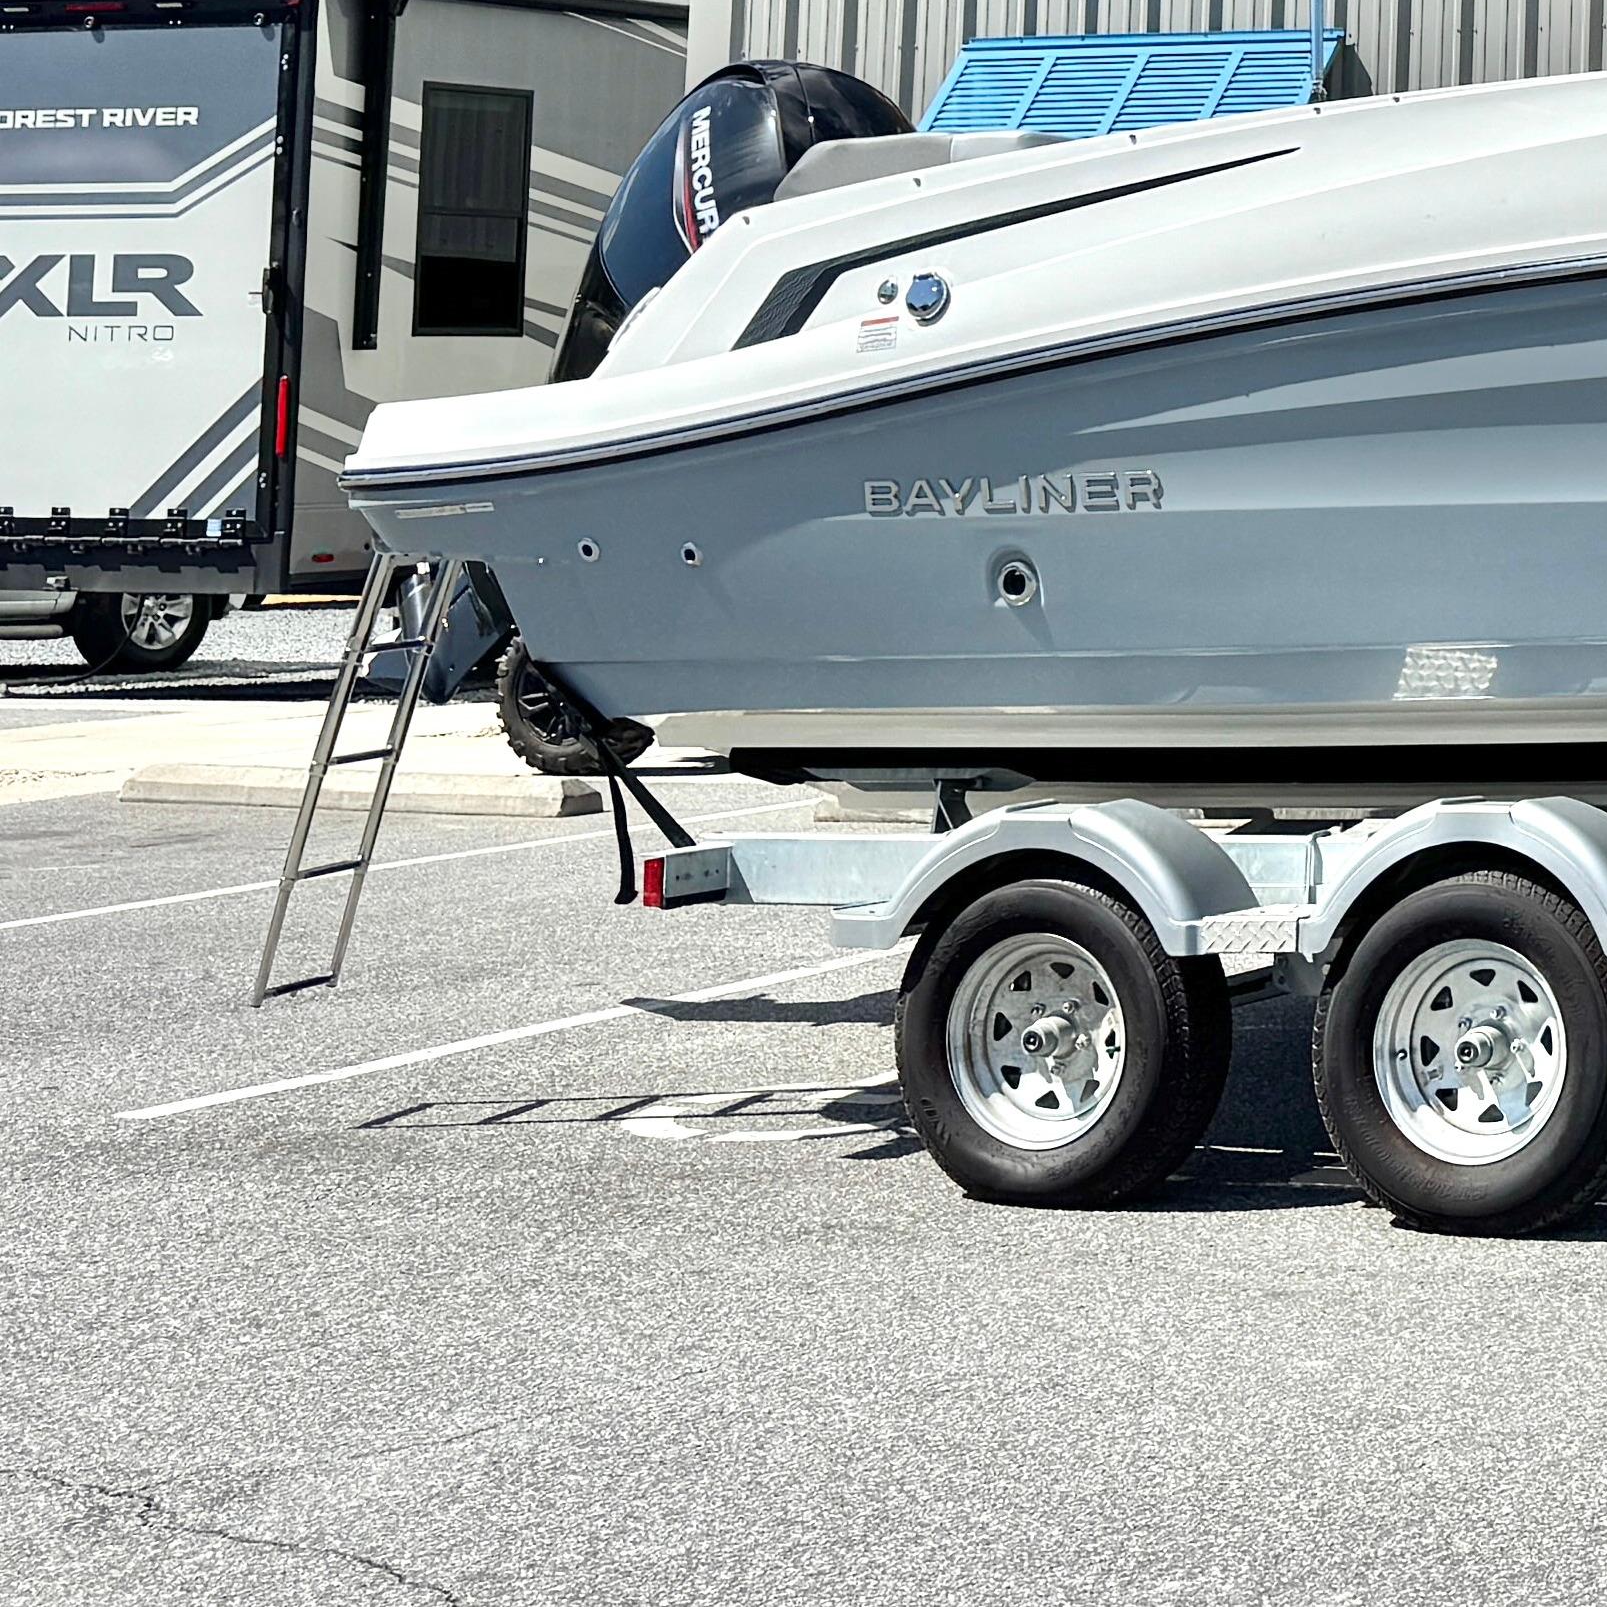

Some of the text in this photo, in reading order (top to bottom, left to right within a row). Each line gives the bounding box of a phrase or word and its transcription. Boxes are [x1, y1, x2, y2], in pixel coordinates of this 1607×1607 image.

[0, 106, 199, 129] OREST RIVER
[691, 105, 720, 238] MERCUR
[0, 253, 204, 318] XLR
[68, 325, 174, 342] NITRO
[864, 469, 1164, 516] BAYLINER
